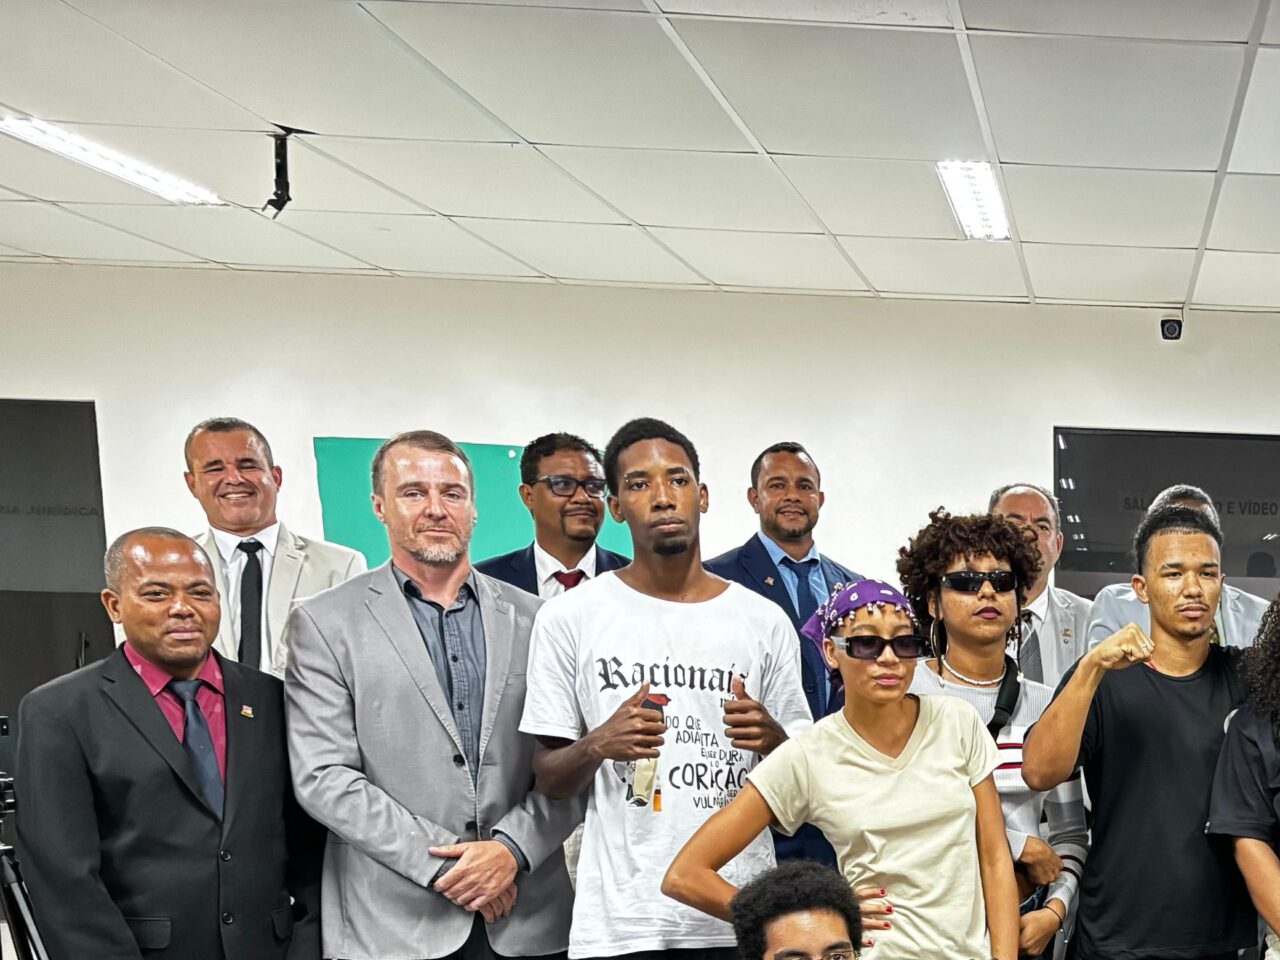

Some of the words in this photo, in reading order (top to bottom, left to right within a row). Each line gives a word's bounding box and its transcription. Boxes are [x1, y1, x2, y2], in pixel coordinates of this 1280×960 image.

[1123, 497, 1149, 511] SAL
[1226, 503, 1235, 515] E
[1238, 499, 1279, 516] VÍDEO
[676, 730, 719, 748] ADIATA
